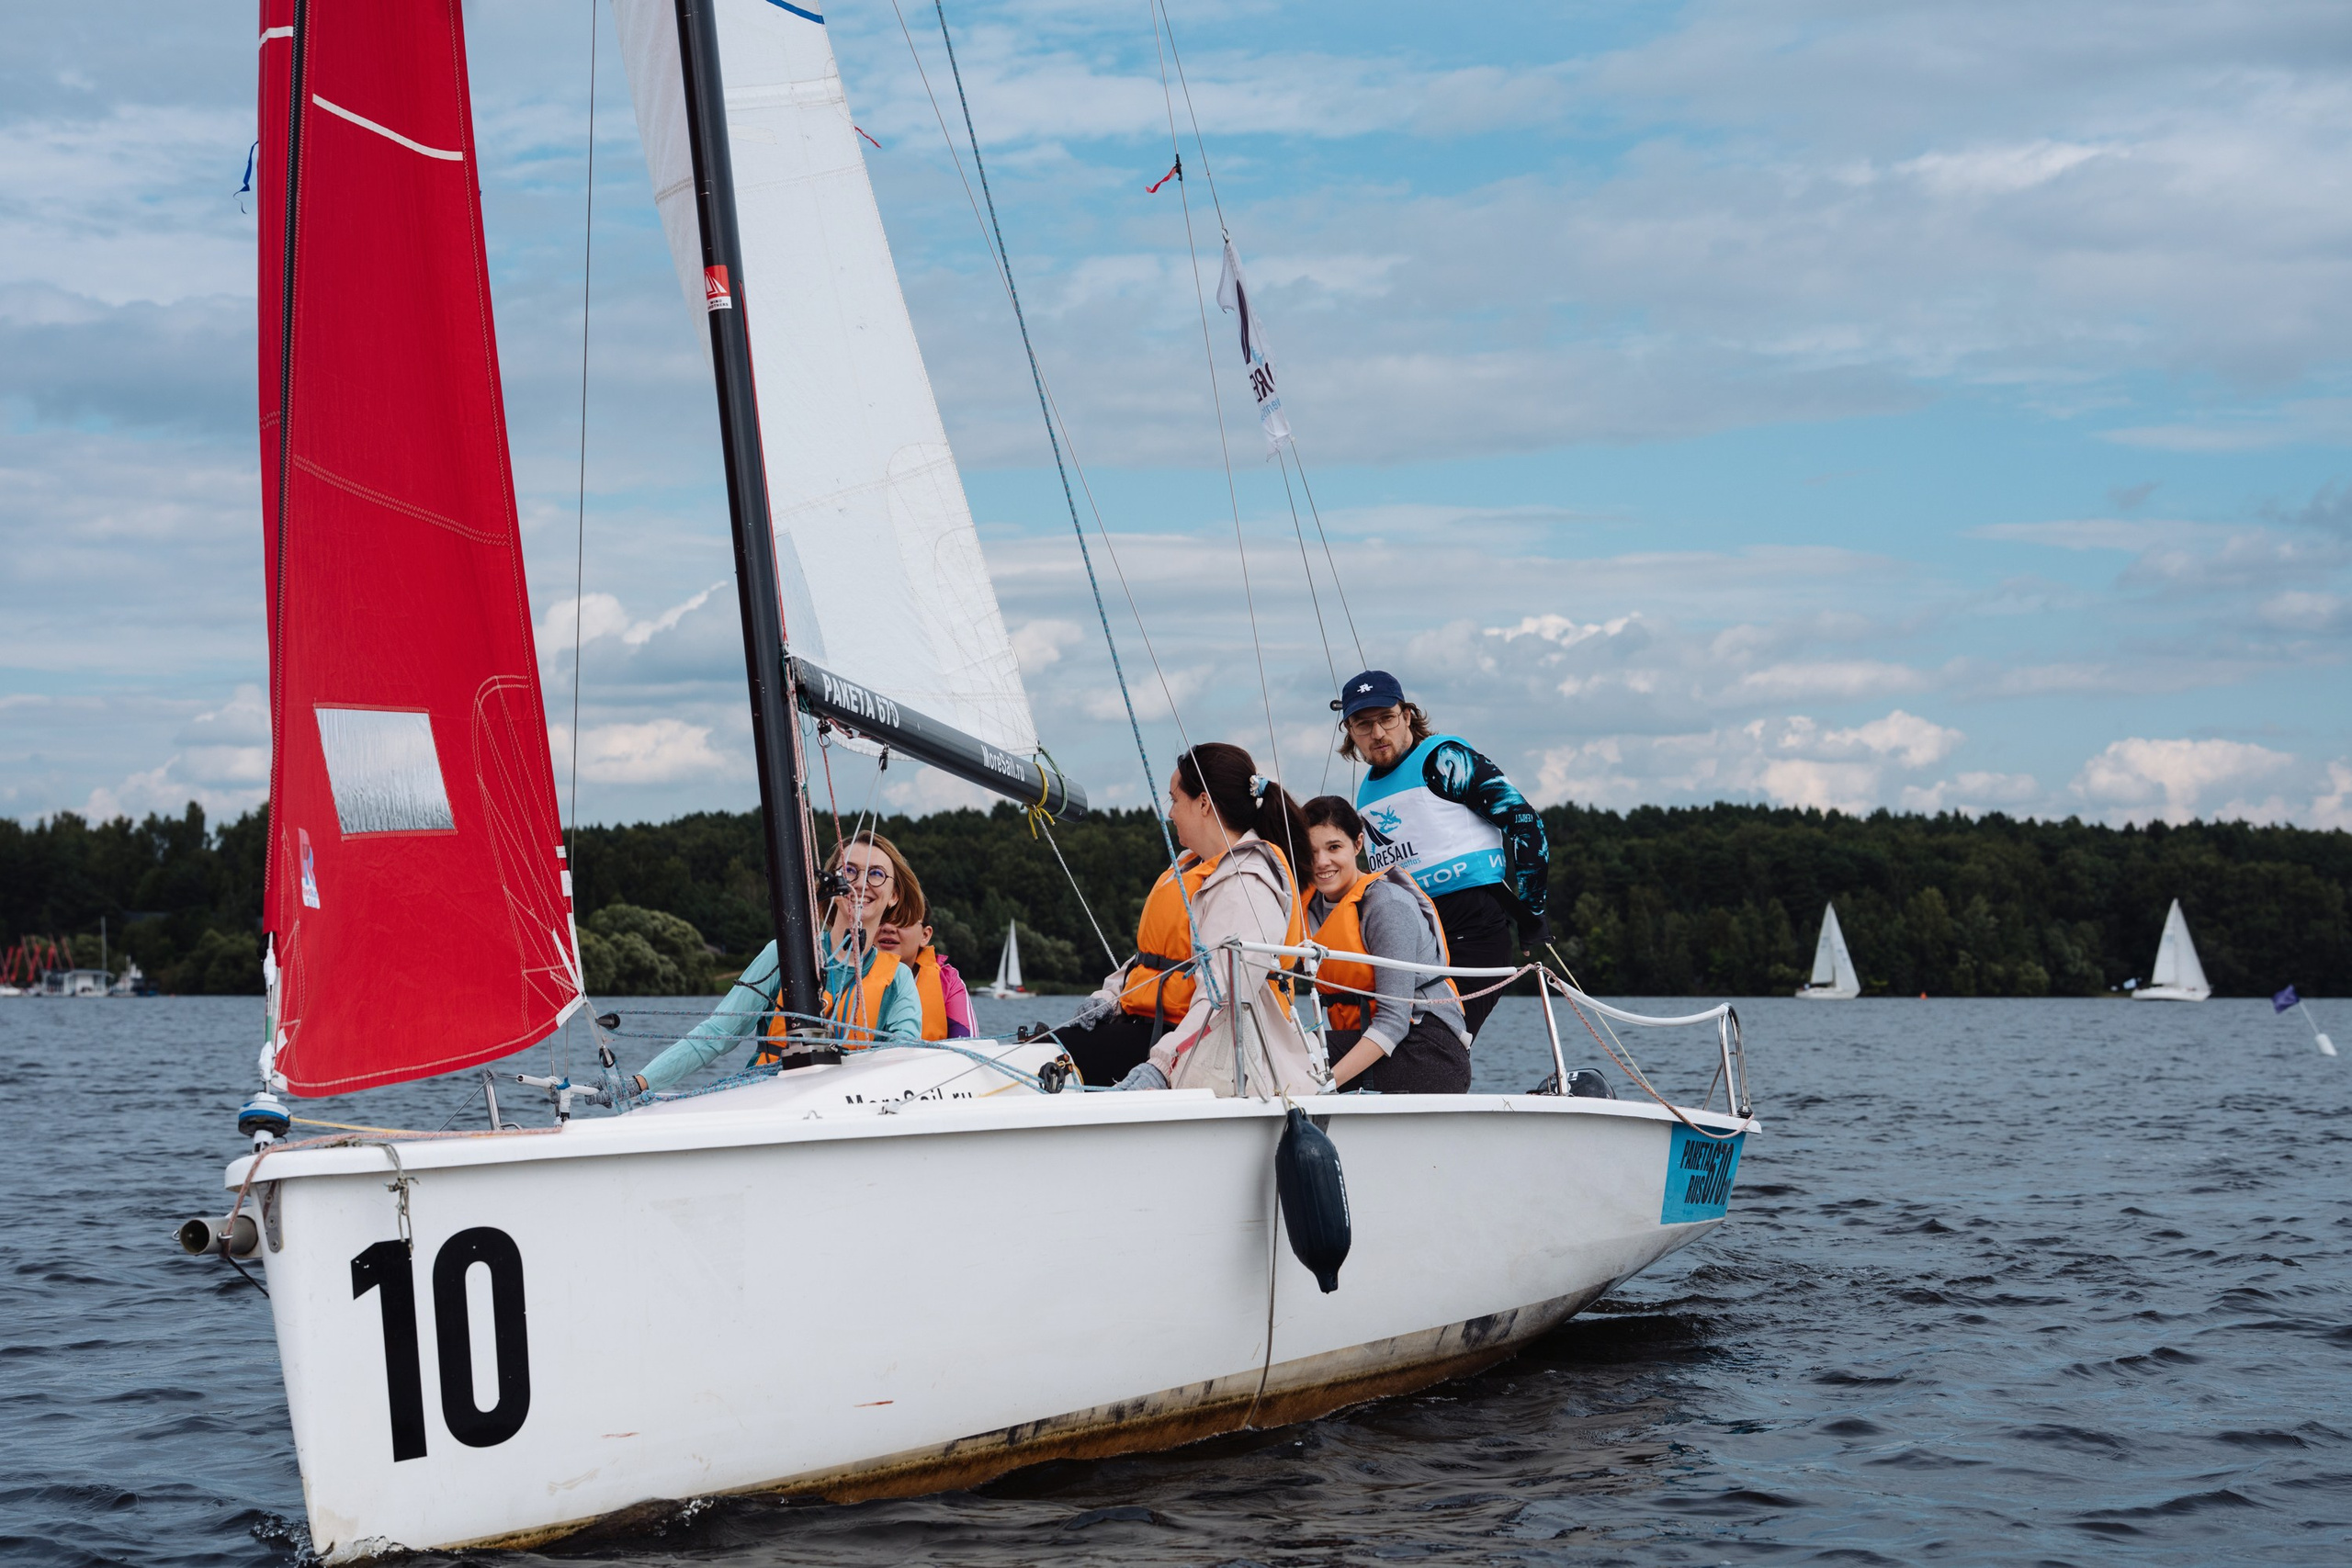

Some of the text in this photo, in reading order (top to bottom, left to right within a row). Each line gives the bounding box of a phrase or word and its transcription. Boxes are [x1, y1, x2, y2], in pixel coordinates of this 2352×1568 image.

[980, 744, 1025, 782] MoreSail.ru
[1369, 841, 1418, 871] ORESAIL
[1684, 1175, 1705, 1204] RUS
[351, 1226, 530, 1462] 10
